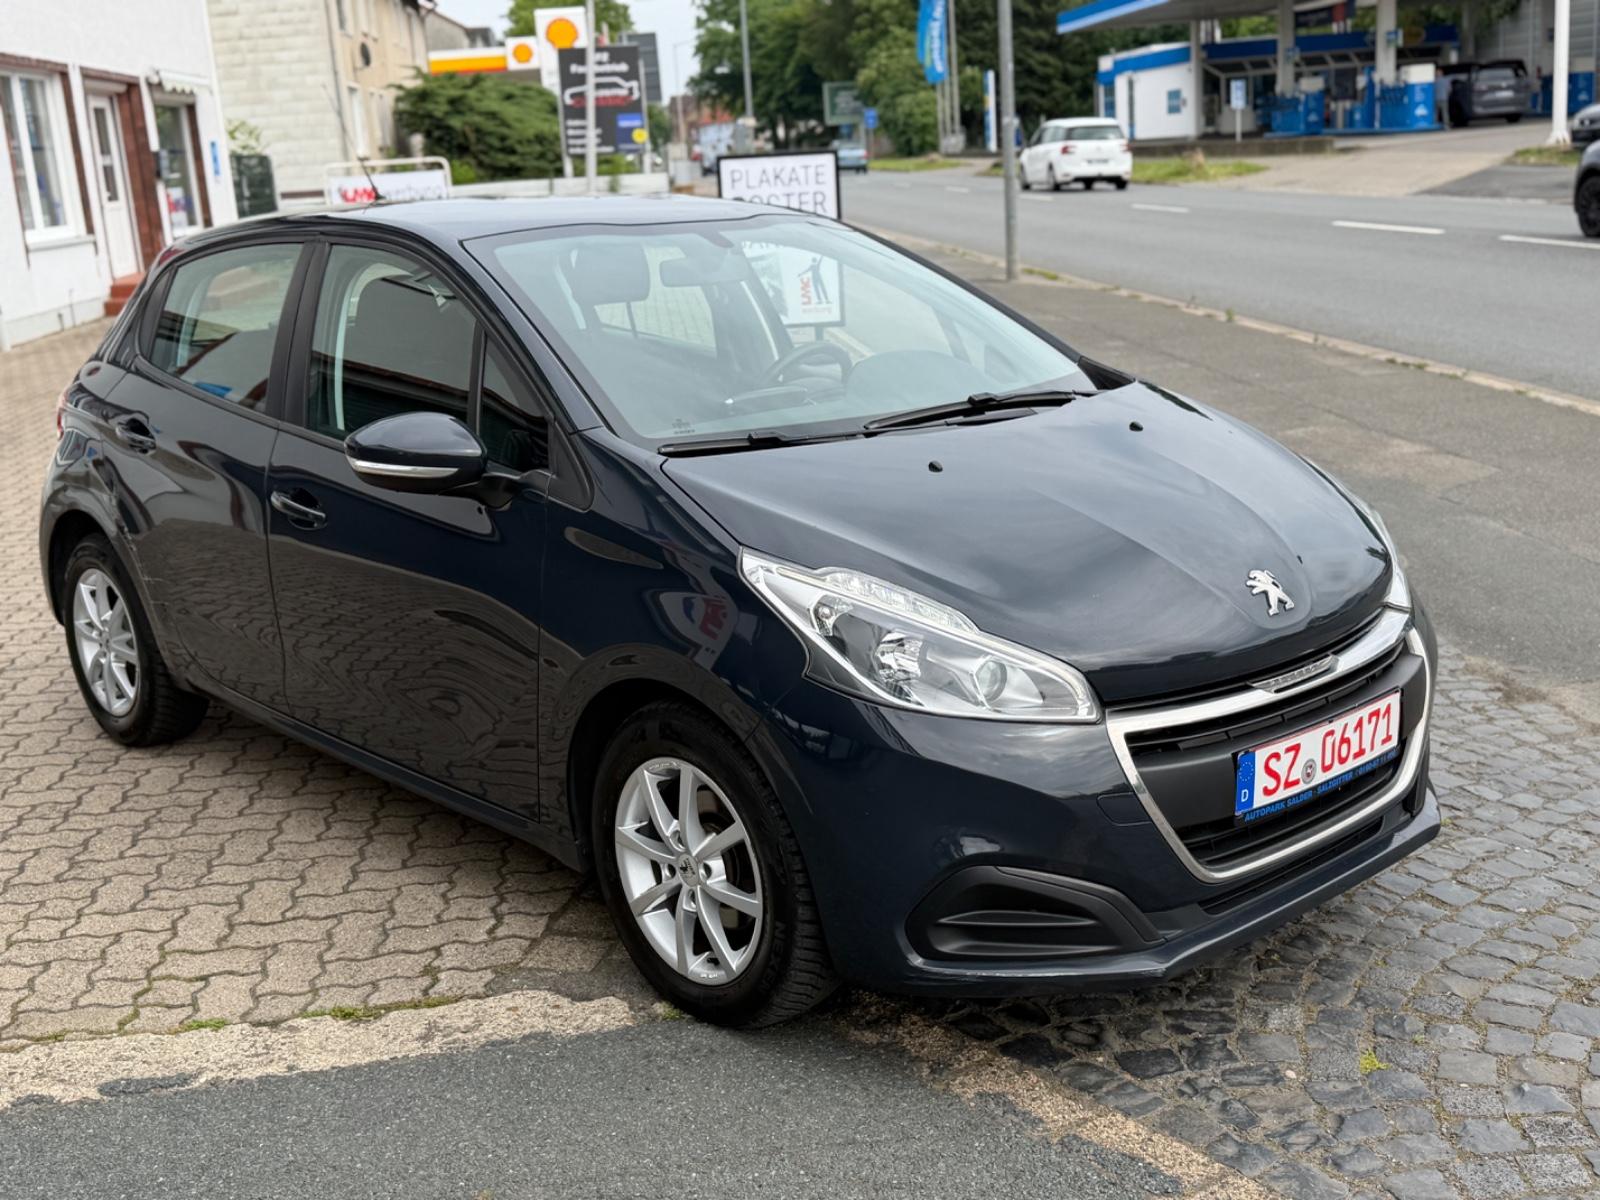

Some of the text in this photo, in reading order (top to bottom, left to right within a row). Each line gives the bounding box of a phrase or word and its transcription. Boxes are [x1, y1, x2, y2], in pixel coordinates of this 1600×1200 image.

[730, 164, 827, 190] PLAKATE
[1262, 743, 1301, 797] SZ
[1321, 704, 1393, 773] 06171
[1240, 788, 1250, 803] D
[1244, 799, 1286, 822] AUTOPARK
